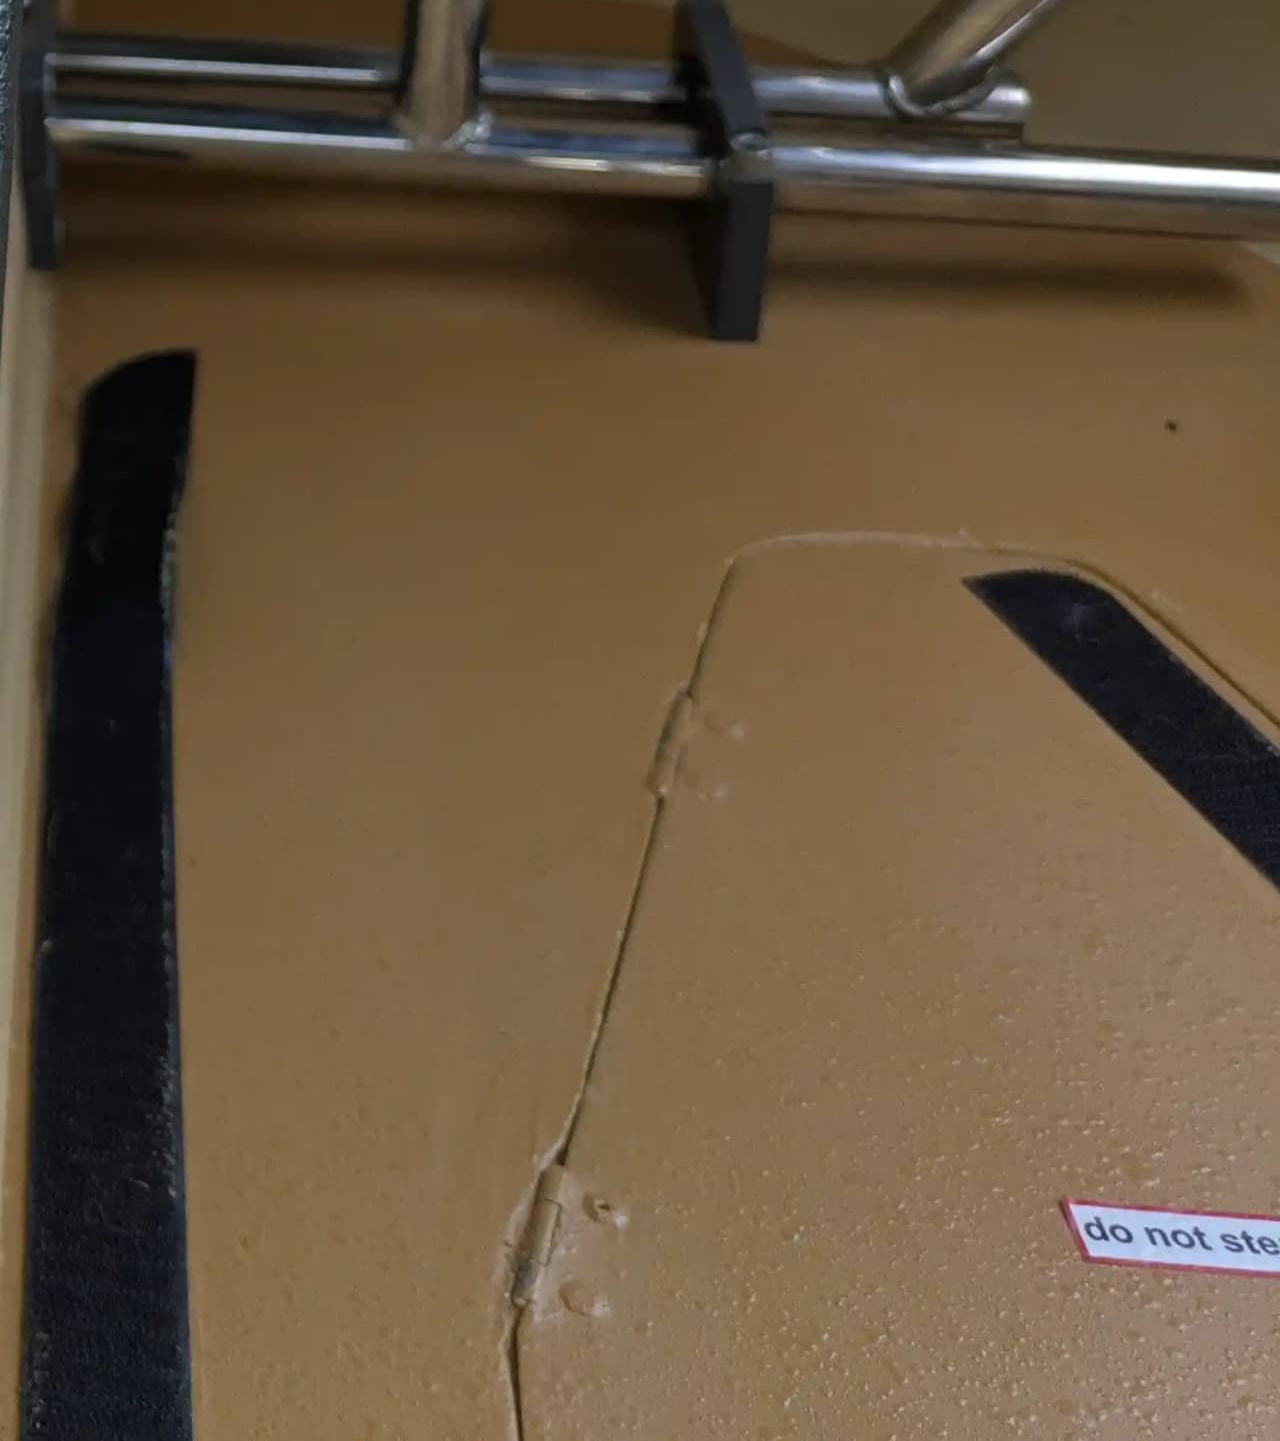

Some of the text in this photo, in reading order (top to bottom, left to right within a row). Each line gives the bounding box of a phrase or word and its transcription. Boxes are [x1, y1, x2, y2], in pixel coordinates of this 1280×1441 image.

[1084, 1216, 1280, 1256] do not ste
